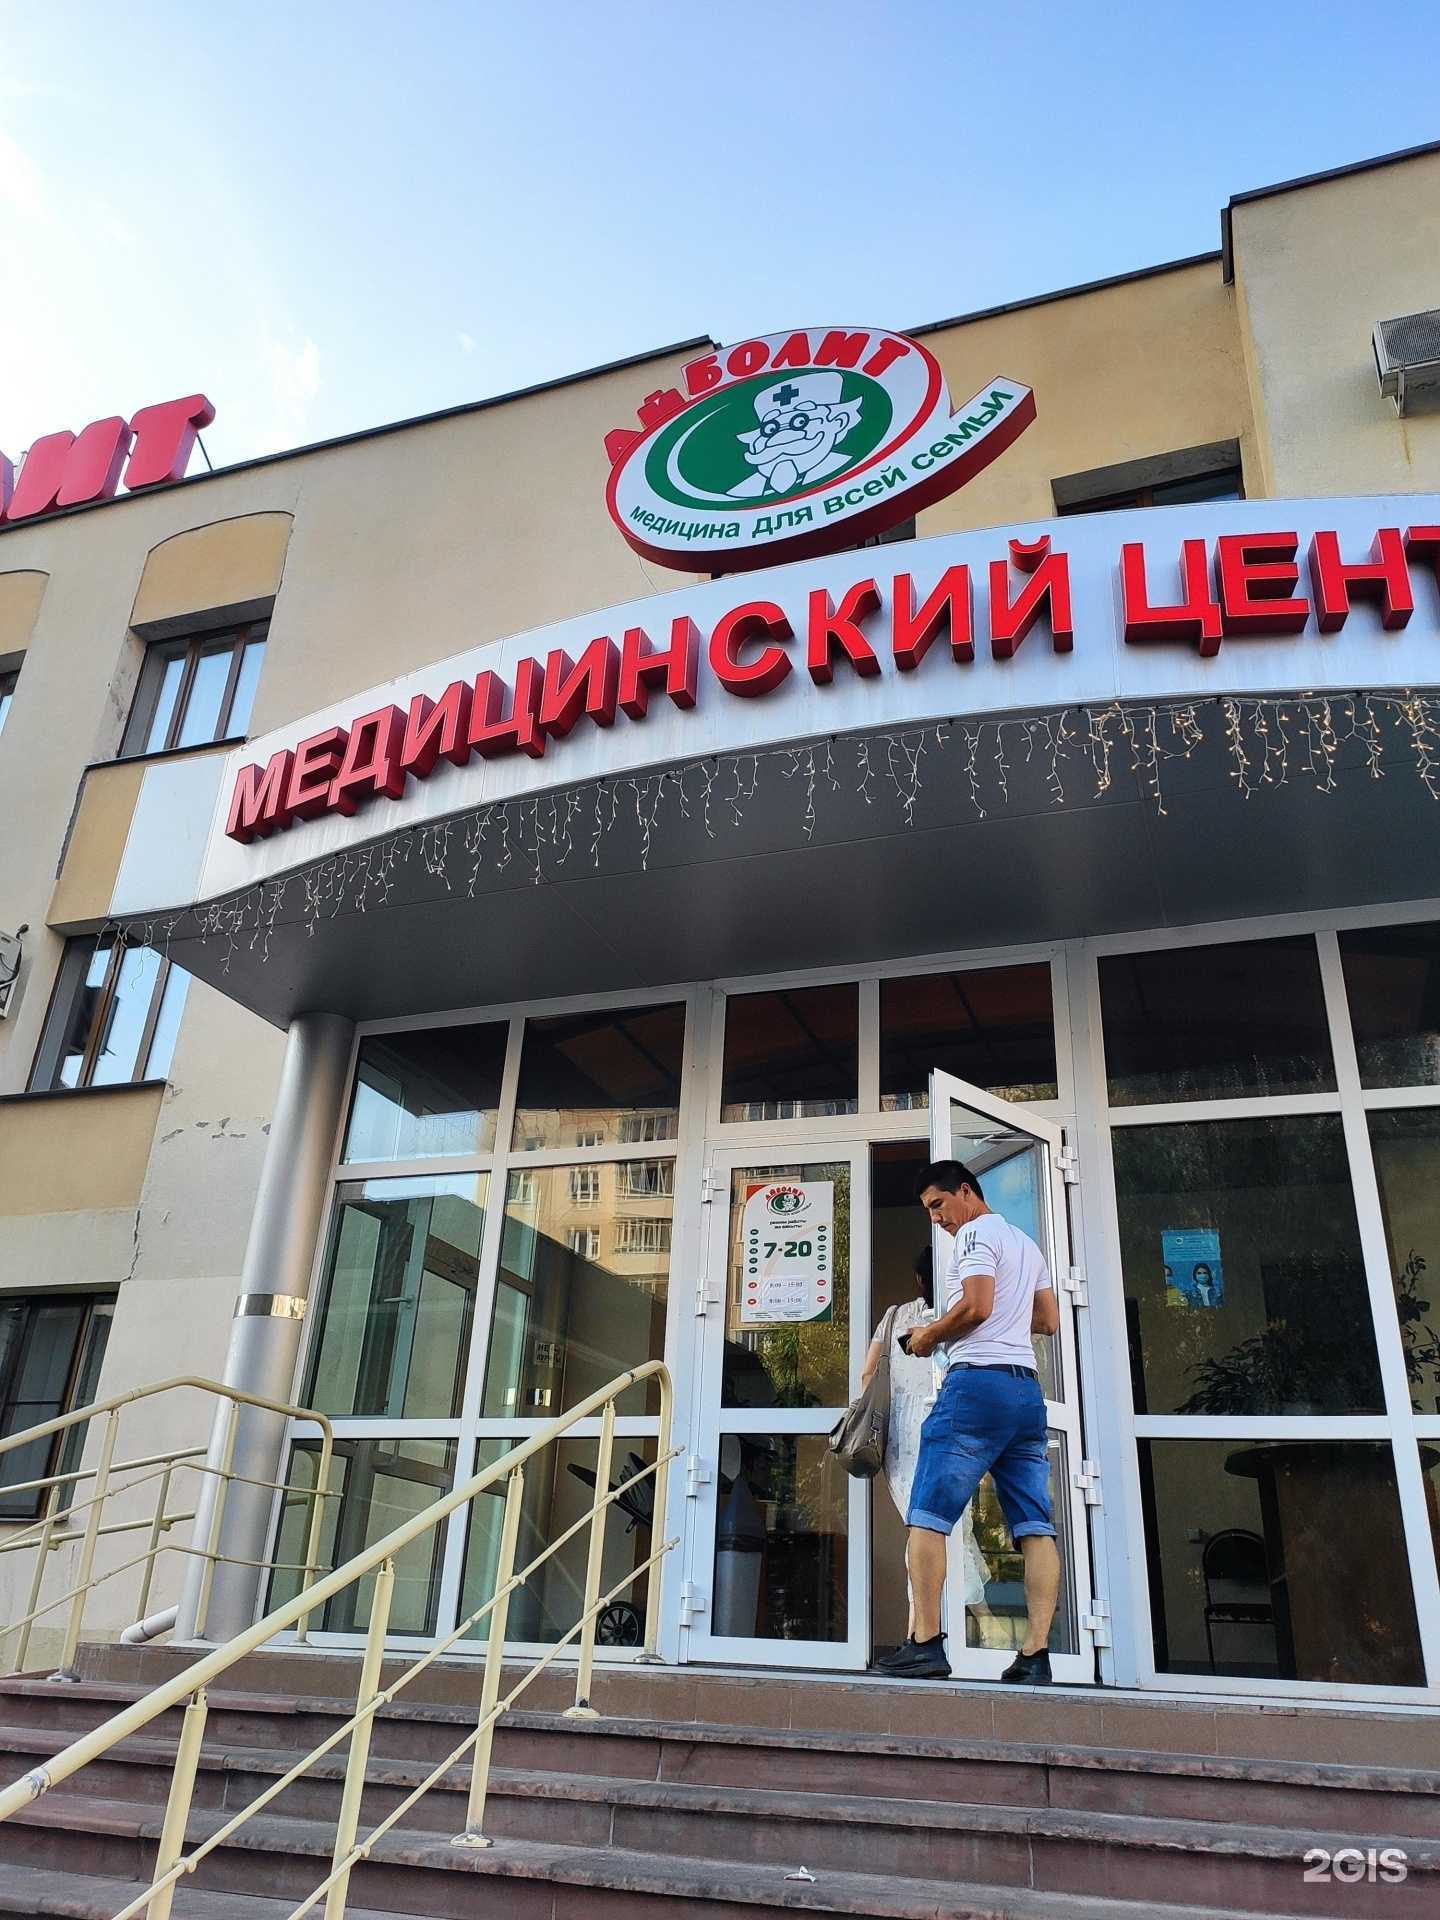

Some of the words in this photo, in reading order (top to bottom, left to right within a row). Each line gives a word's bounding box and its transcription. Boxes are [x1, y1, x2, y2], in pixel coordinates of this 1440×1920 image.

[0, 393, 216, 522] ИТ
[630, 505, 740, 540] медицина
[751, 505, 814, 539] для
[824, 466, 908, 514] всей
[911, 387, 1015, 470] семьи
[225, 534, 1074, 844] МЕДИЦИНСКИЙ
[763, 1240, 812, 1259] 7-20
